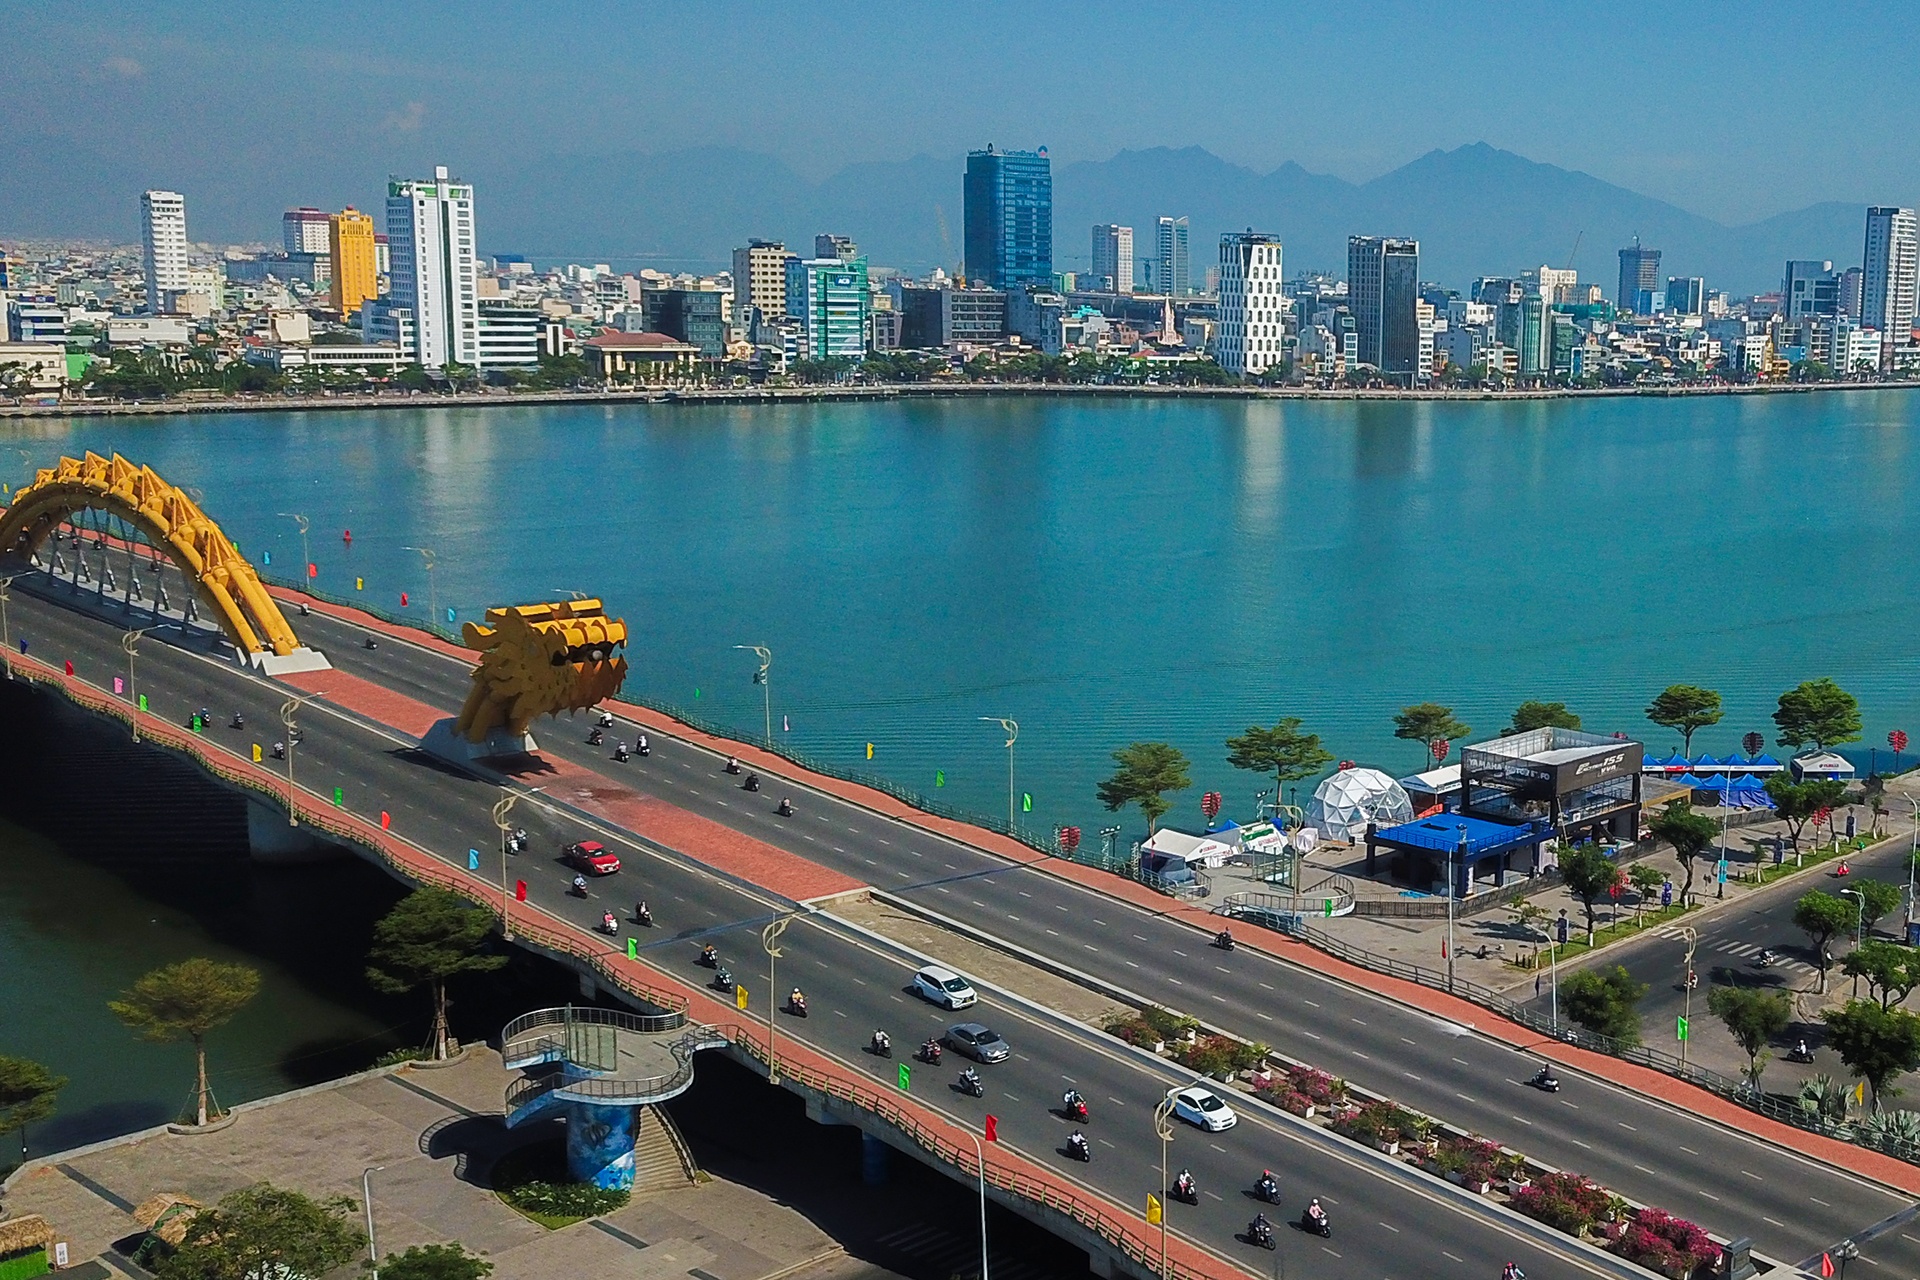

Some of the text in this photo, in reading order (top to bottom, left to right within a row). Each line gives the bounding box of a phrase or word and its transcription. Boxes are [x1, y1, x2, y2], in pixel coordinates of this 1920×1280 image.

[1603, 753, 1625, 766] 155
[1469, 758, 1503, 771] YAMAHA
[1530, 770, 1550, 781] EPO
